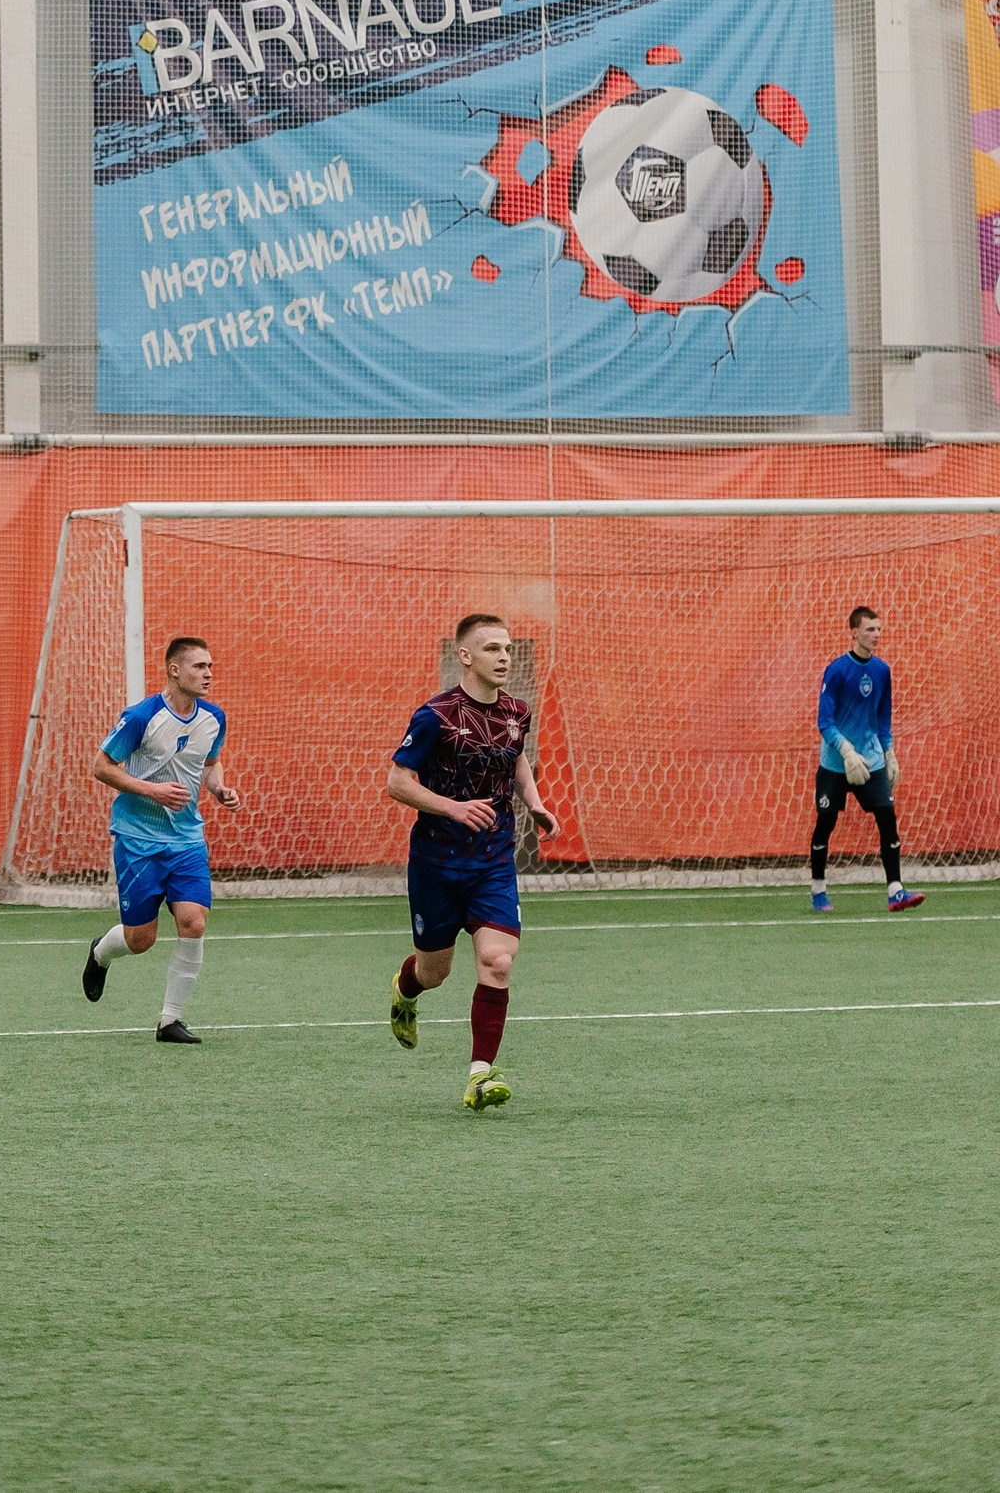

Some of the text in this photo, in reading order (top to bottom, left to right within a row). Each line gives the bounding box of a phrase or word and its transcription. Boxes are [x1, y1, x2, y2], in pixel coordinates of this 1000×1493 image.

[145, 77, 262, 119] ИНТЕРНЕТ
[281, 38, 437, 90] СООБЩЕСТВО
[137, 155, 353, 244] ГЕНЕРАЛЬНЫЙ
[140, 199, 432, 310] ИНФОРМАЦИОННЫЙ
[140, 267, 454, 371] ПАРТНЕР ФК «ТЕМП»
